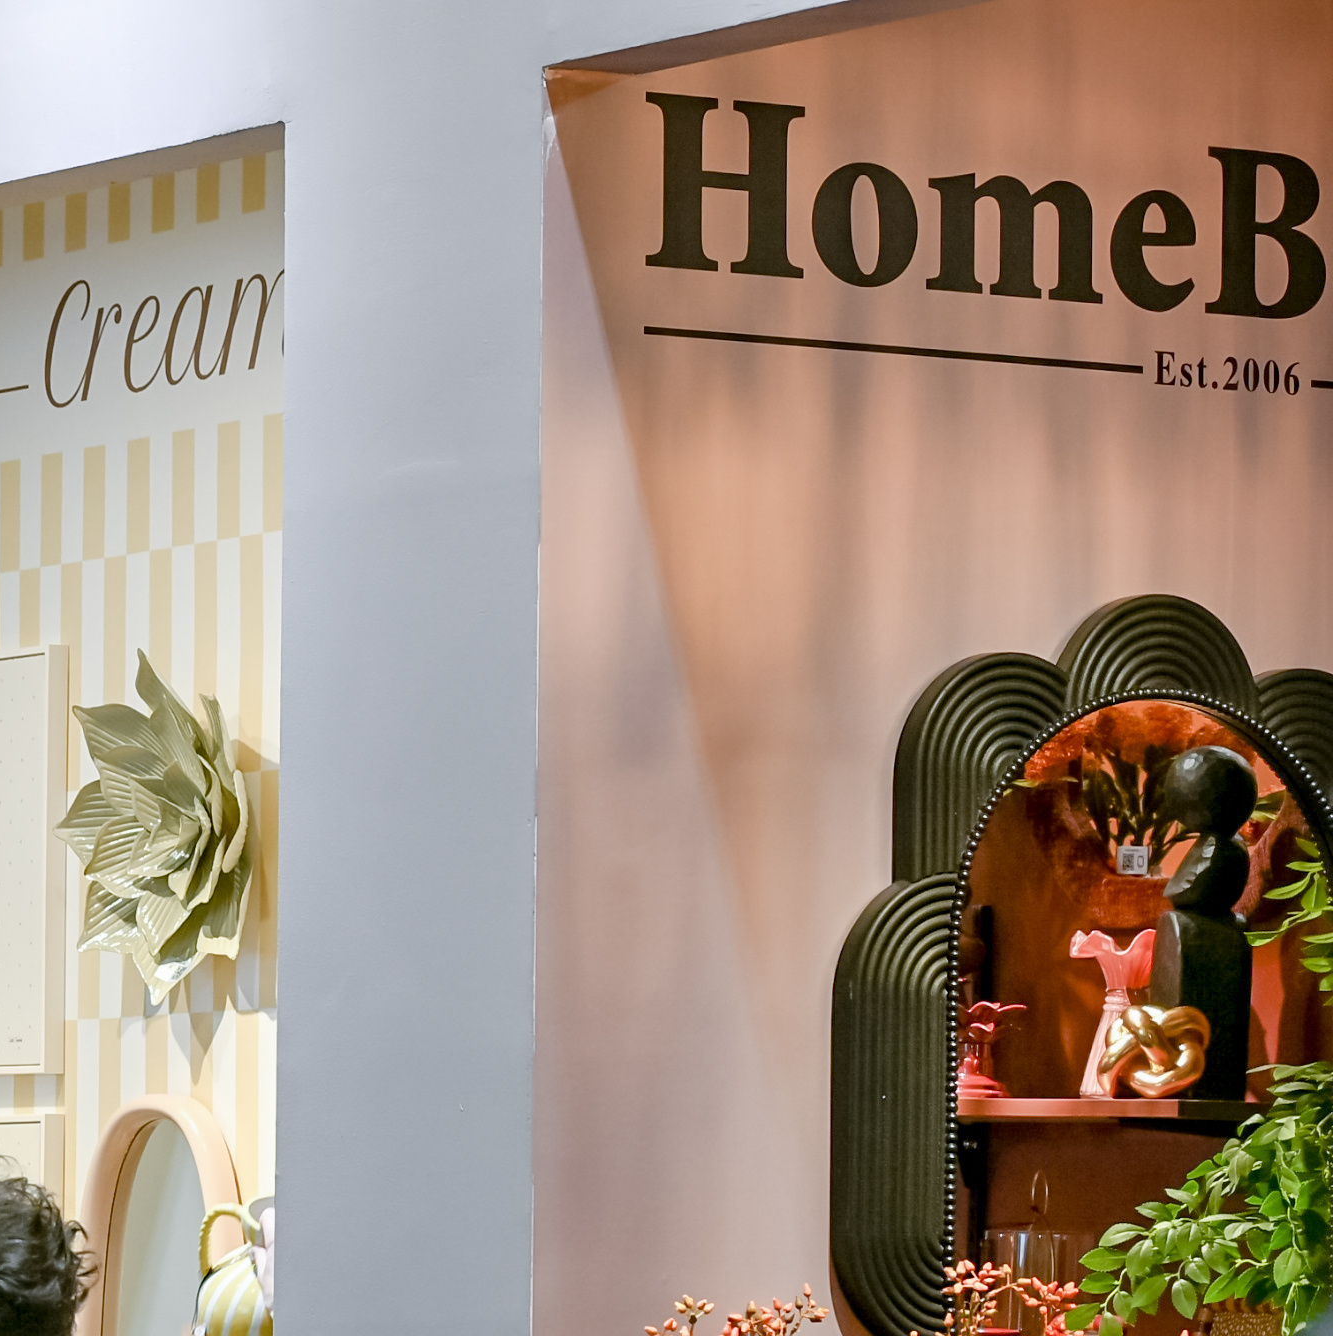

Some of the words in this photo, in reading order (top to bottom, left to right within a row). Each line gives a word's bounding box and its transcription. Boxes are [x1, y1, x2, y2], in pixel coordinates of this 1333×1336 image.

[645, 91, 1327, 319] HomeB
[44, 270, 285, 408] Cream
[1153, 350, 1301, 396] Est.2006
